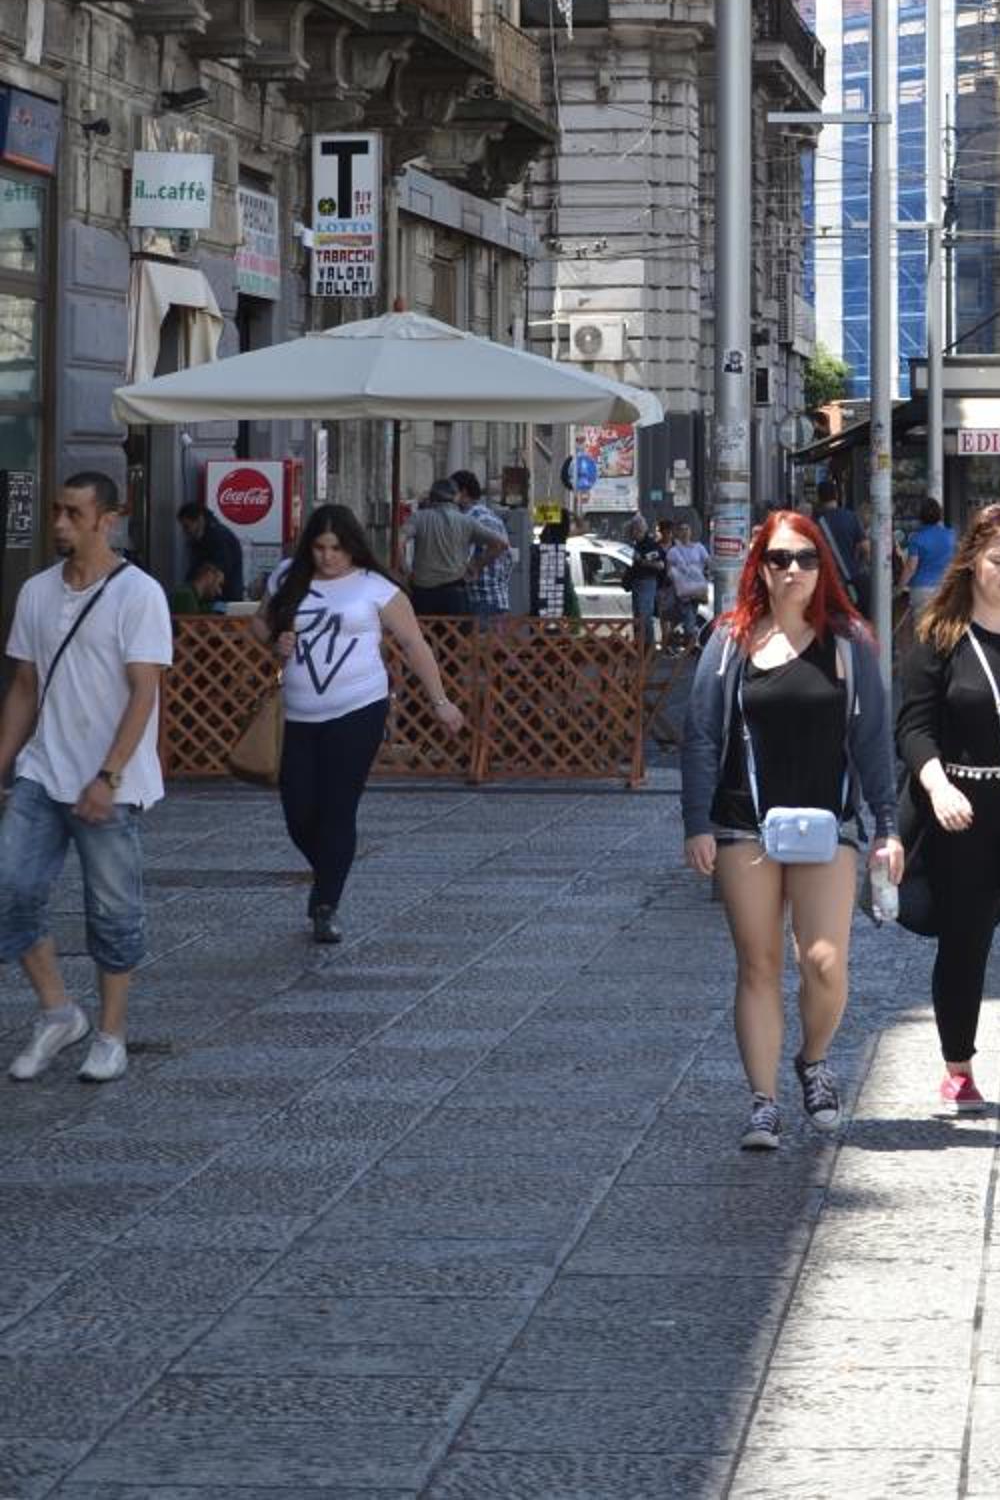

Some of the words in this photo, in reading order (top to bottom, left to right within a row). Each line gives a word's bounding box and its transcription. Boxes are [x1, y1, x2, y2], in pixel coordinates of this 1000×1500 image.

[321, 141, 369, 218] T
[317, 222, 372, 233] LOTTO
[316, 250, 374, 263] TABACCHI
[318, 266, 371, 281] VALORI
[316, 281, 373, 295] BOLLATI
